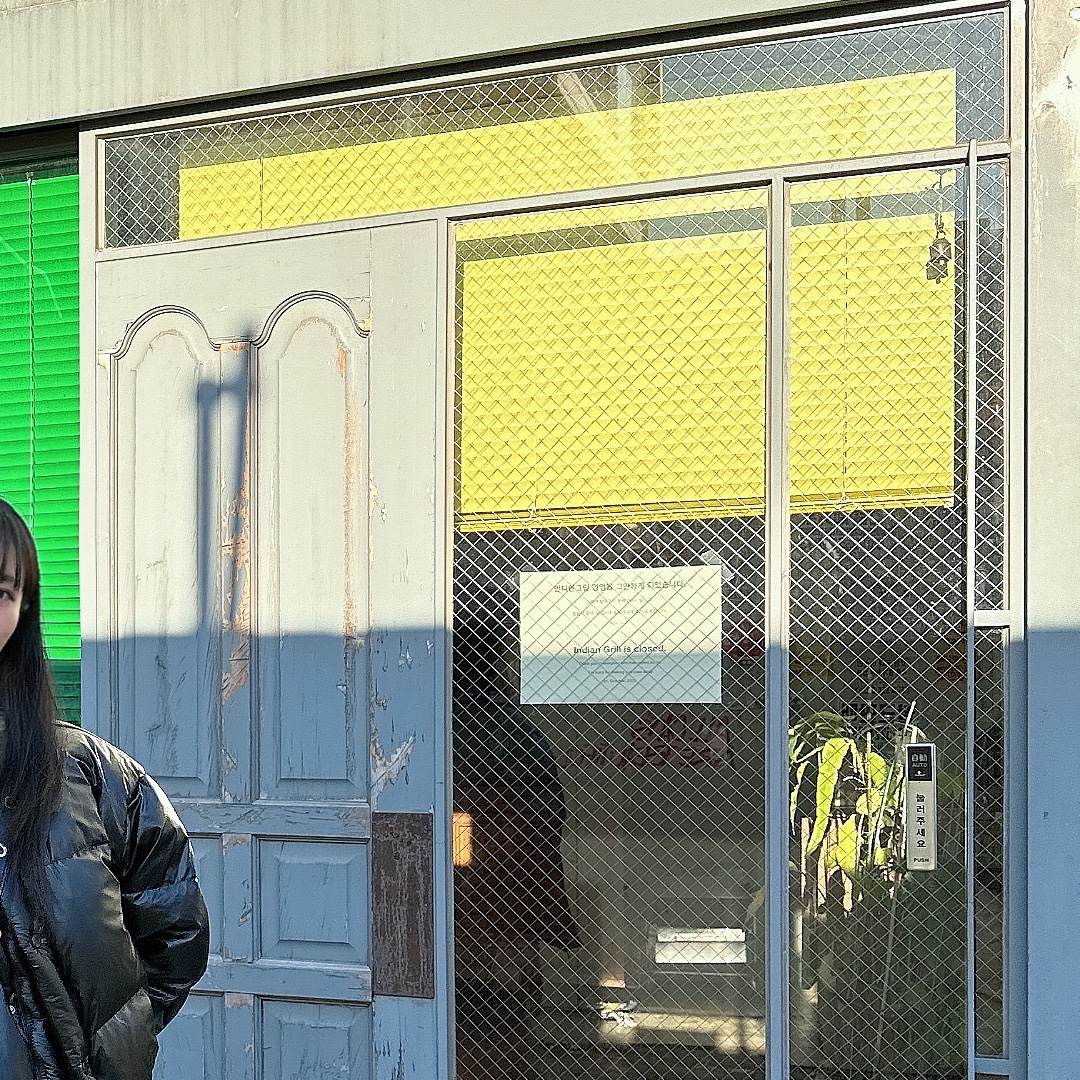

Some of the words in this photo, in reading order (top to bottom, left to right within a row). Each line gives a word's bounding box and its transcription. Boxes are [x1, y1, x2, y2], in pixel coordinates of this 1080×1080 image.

[573, 645, 601, 654] Indian
[603, 645, 621, 653] Grill
[624, 645, 631, 653] is
[633, 644, 667, 653] closed.
[915, 793, 927, 848] 눌러주세요
